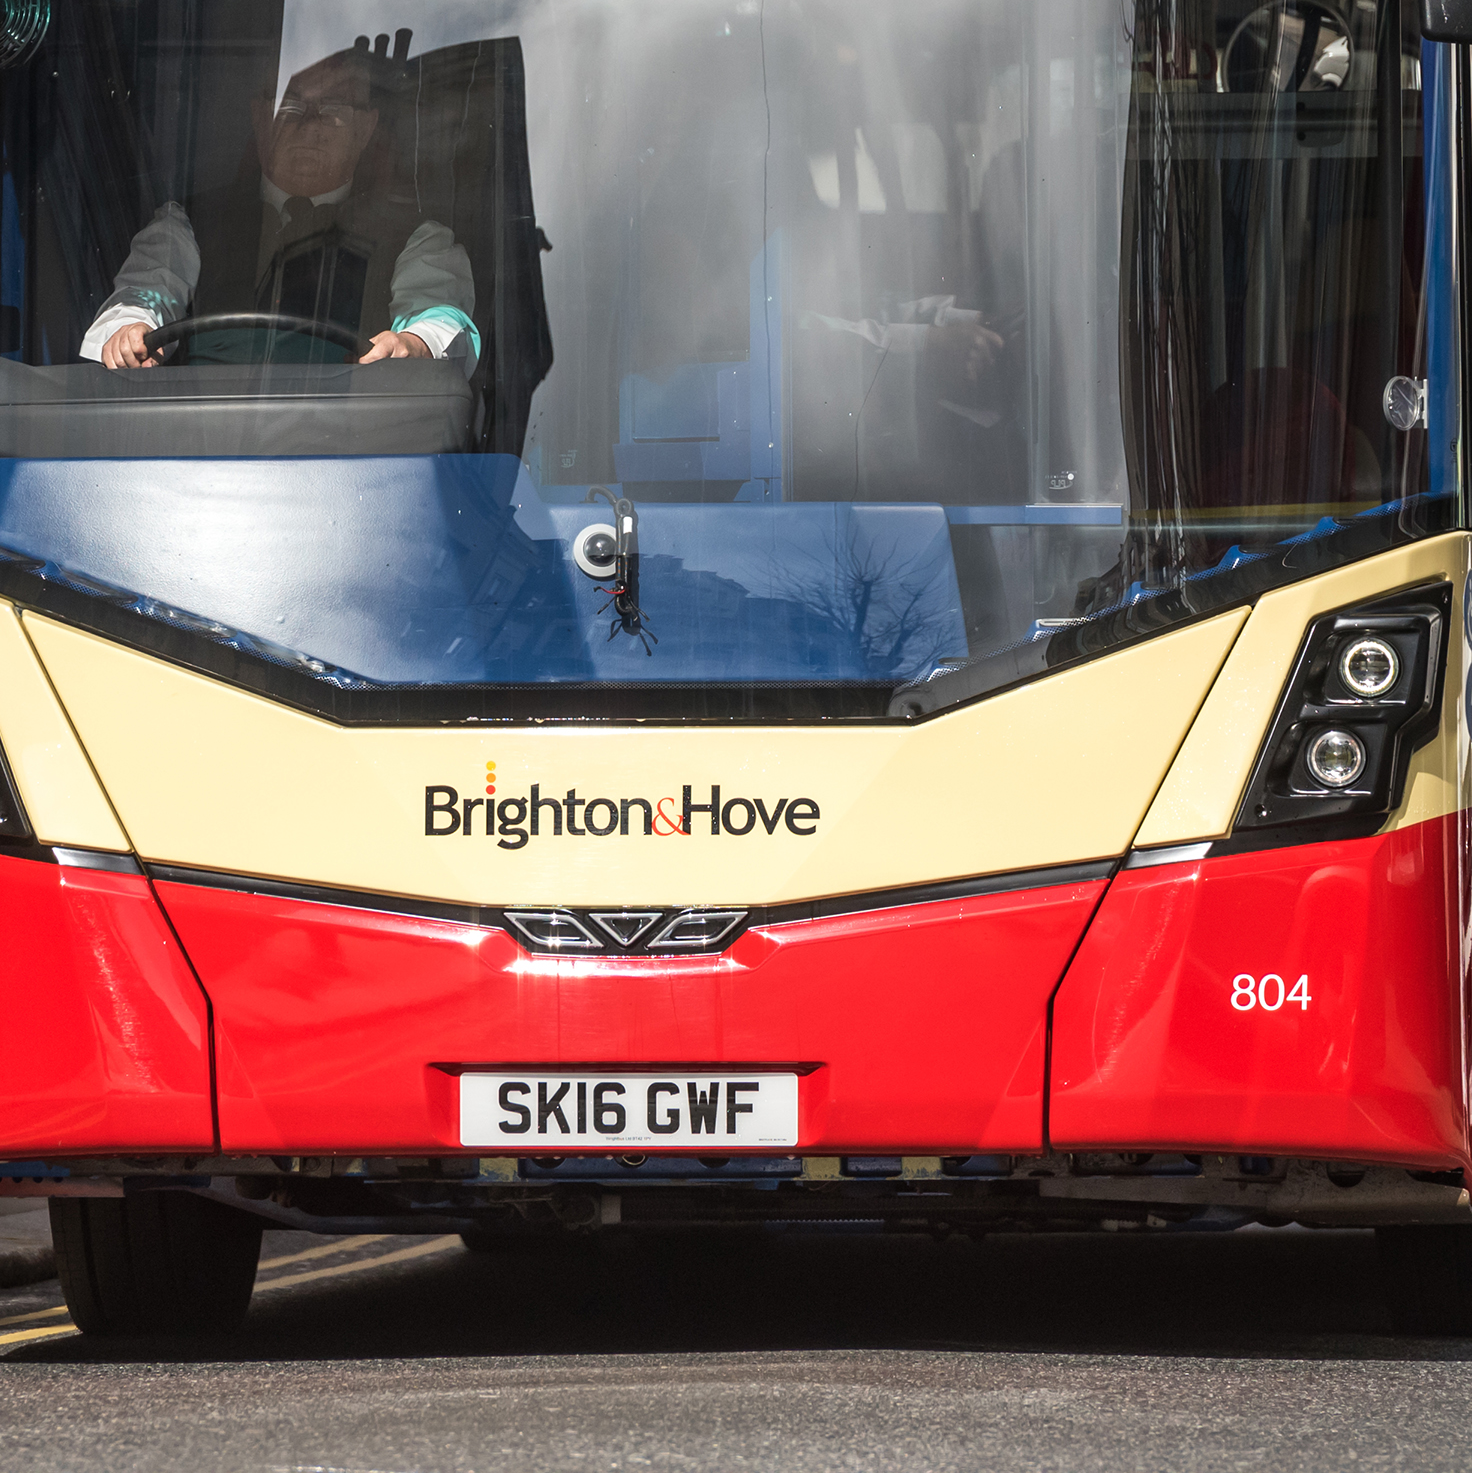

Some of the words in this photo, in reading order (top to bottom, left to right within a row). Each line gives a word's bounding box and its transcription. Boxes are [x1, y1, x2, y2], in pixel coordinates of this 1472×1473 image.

[424, 776, 821, 850] Brighton&Hove
[1230, 973, 1312, 1011] 804
[498, 1081, 627, 1134] SK16
[646, 1081, 760, 1134] GWF
